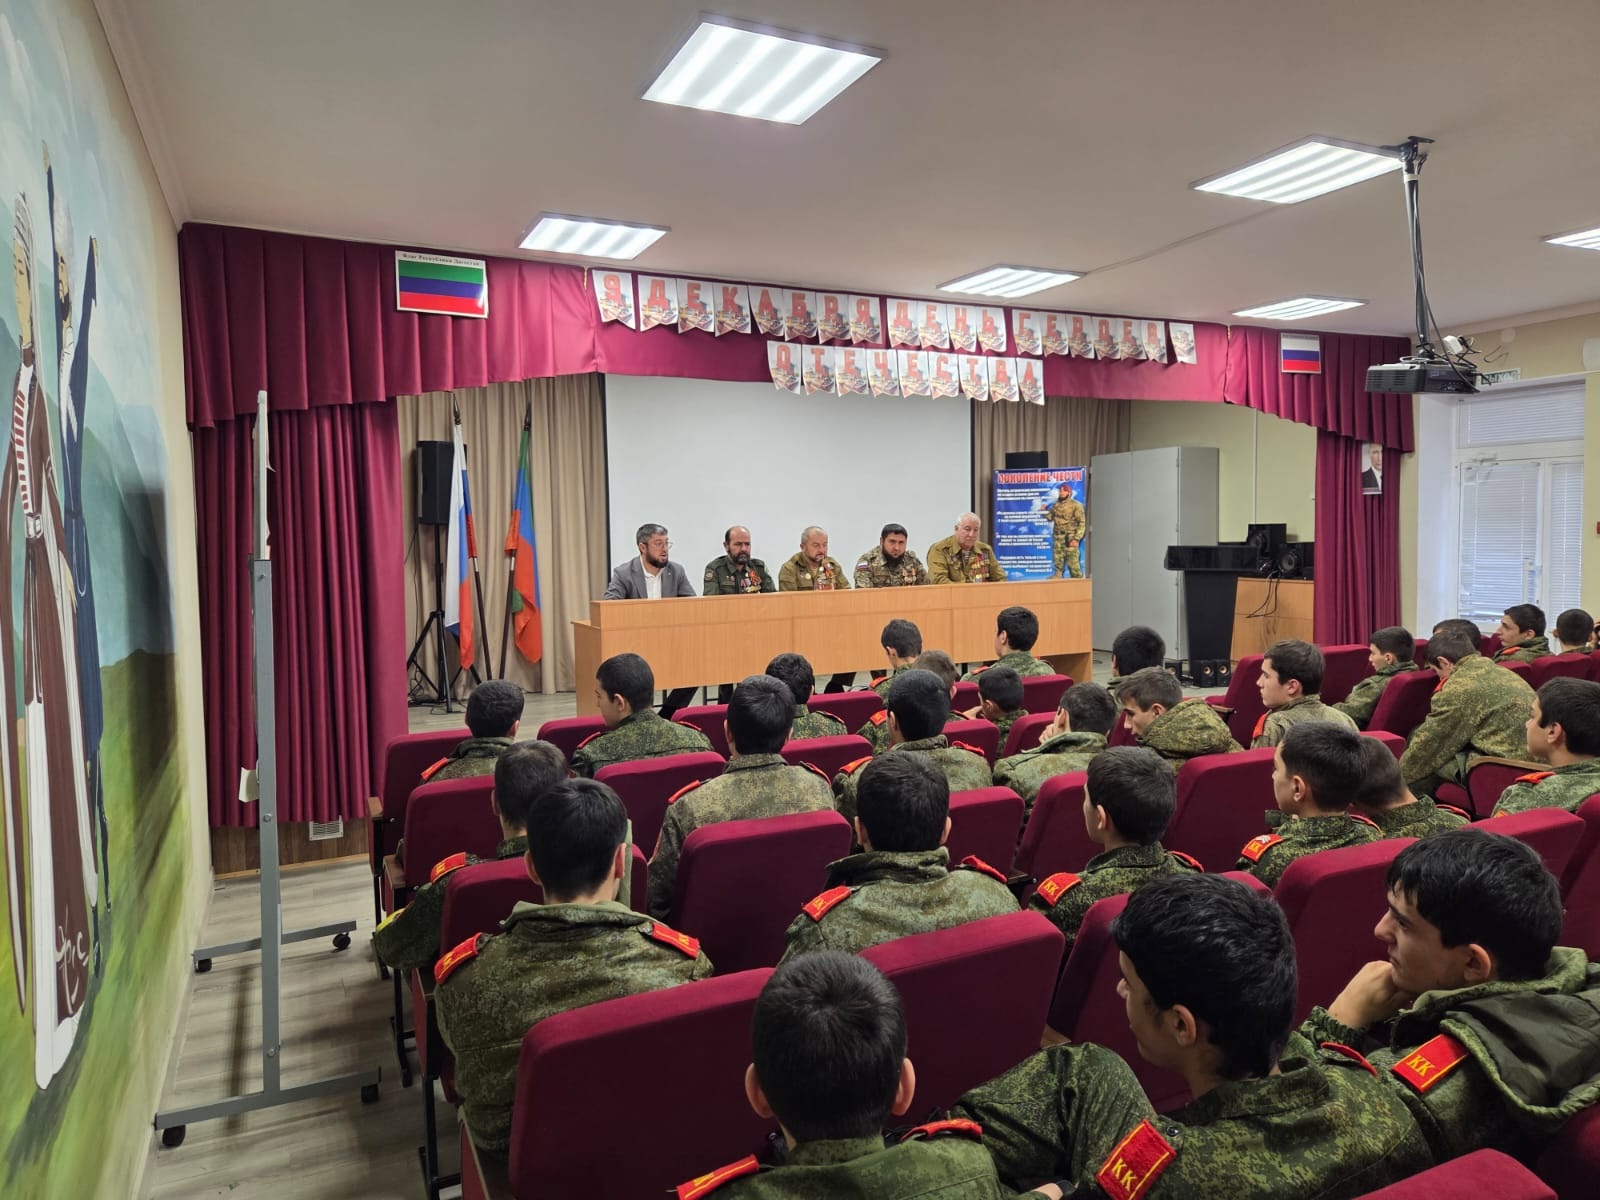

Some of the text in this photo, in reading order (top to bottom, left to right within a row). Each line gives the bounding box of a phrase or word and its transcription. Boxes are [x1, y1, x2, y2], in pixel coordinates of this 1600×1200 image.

[603, 274, 1159, 345] 9 ДЕКАБРЯ ДЕНЬ ГЕРОЕВ
[776, 344, 1038, 387] ОТЕЧЕСТВА
[1406, 1054, 1436, 1077] КК
[1111, 1158, 1138, 1192] КК
